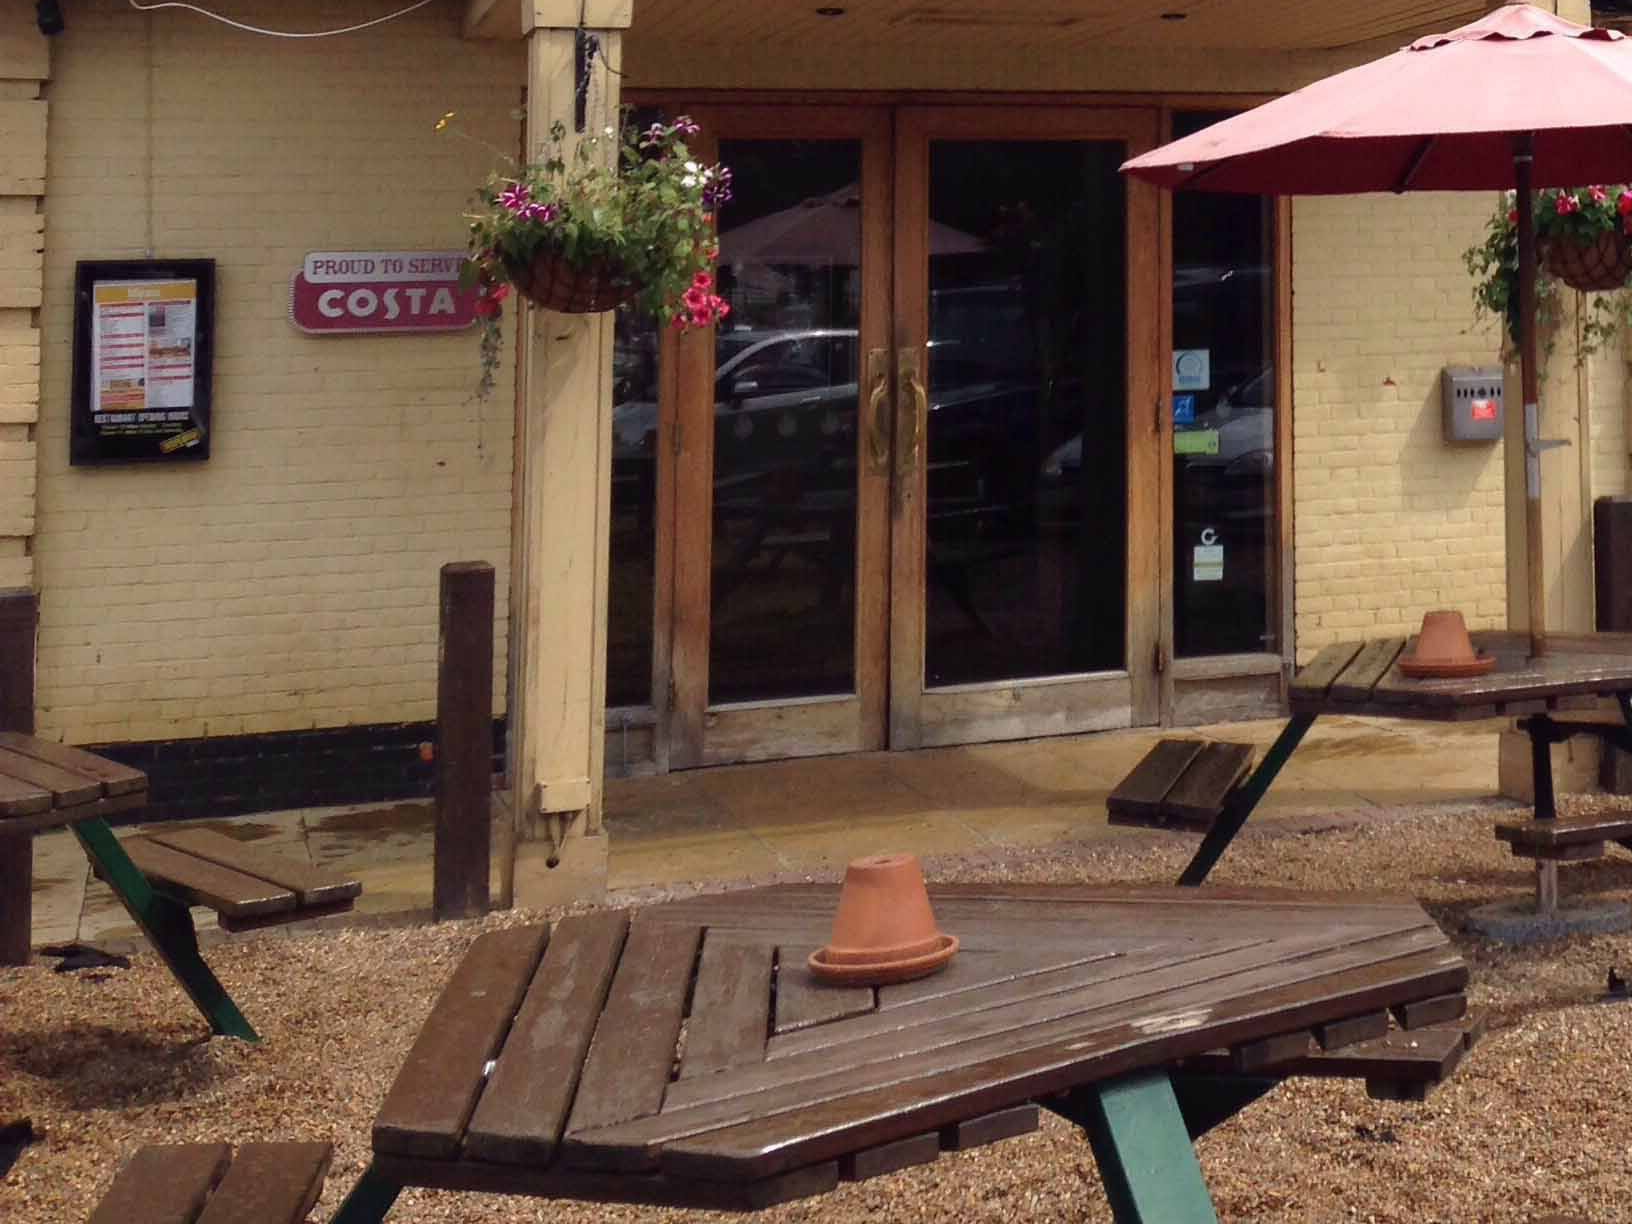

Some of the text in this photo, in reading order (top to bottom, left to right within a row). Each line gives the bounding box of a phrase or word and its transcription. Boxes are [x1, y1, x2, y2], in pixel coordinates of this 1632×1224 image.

[312, 259, 376, 276] PROUD
[380, 258, 403, 274] TO
[317, 287, 457, 320] COSTA
